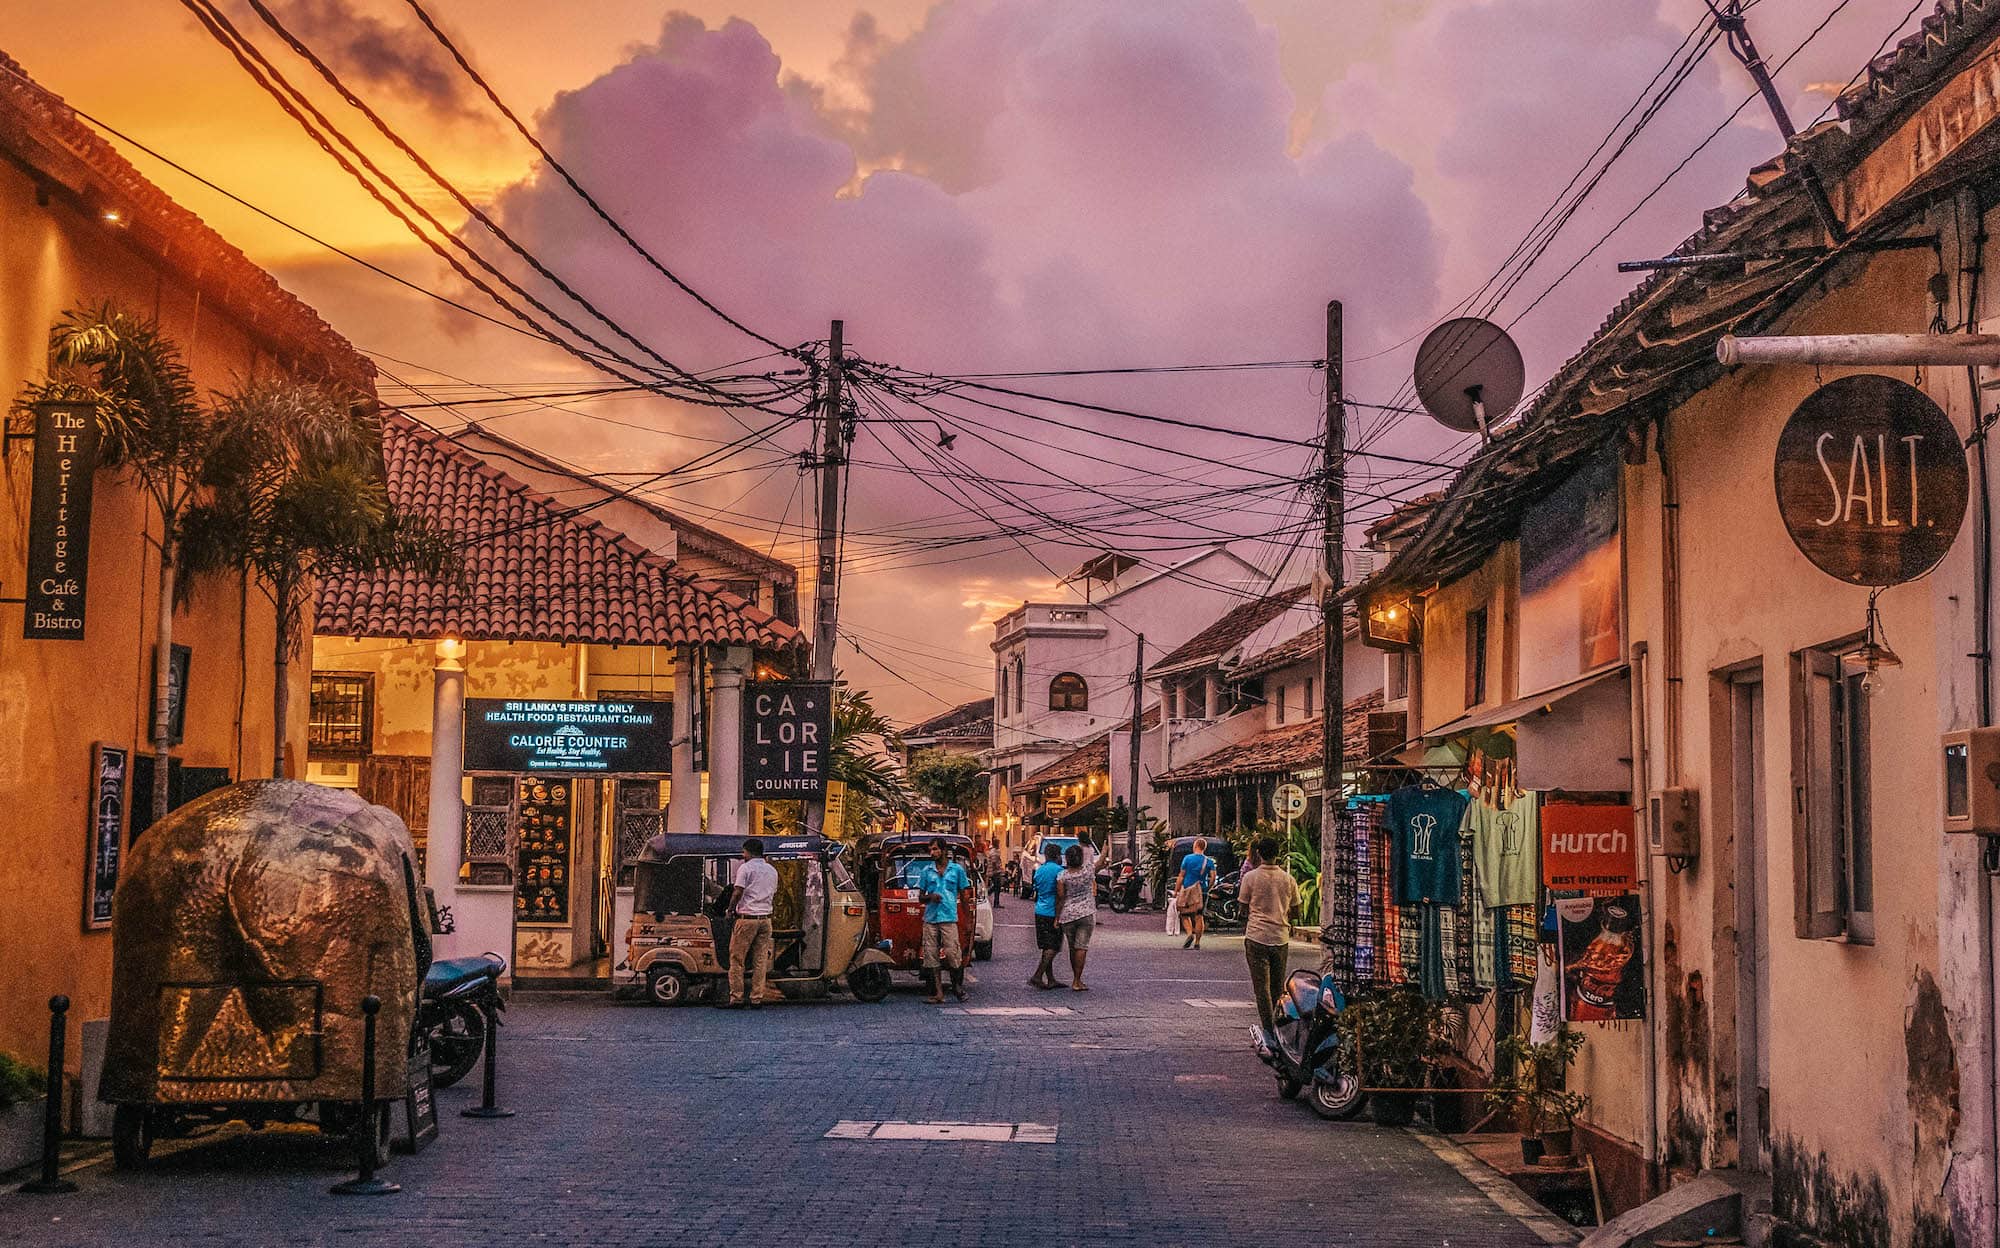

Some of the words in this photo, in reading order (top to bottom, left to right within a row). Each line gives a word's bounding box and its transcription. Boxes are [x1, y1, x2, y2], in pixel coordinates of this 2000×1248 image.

[51, 412, 86, 430] The
[1815, 431, 1935, 528] SALT.
[55, 434, 78, 574] Heritage
[40, 578, 79, 596] Café
[51, 598, 65, 612] &
[33, 612, 82, 630] Bistro
[505, 702, 523, 711] SRI
[524, 702, 567, 712] LANKA'S
[568, 703, 597, 713] FIRST
[598, 704, 606, 713] &
[607, 704, 634, 714] ONLY
[486, 712, 525, 722] HEALTH
[527, 712, 555, 722] FOOD
[556, 713, 621, 723] RESTAURANT
[622, 714, 653, 724] CHAIN
[511, 735, 565, 747] CALORIE
[568, 736, 628, 748] COUNTER
[755, 779, 819, 790] COUNTER
[1551, 875, 1576, 885] BEST
[1578, 874, 1629, 885] INTERNET
[1585, 991, 1604, 1003] zero
